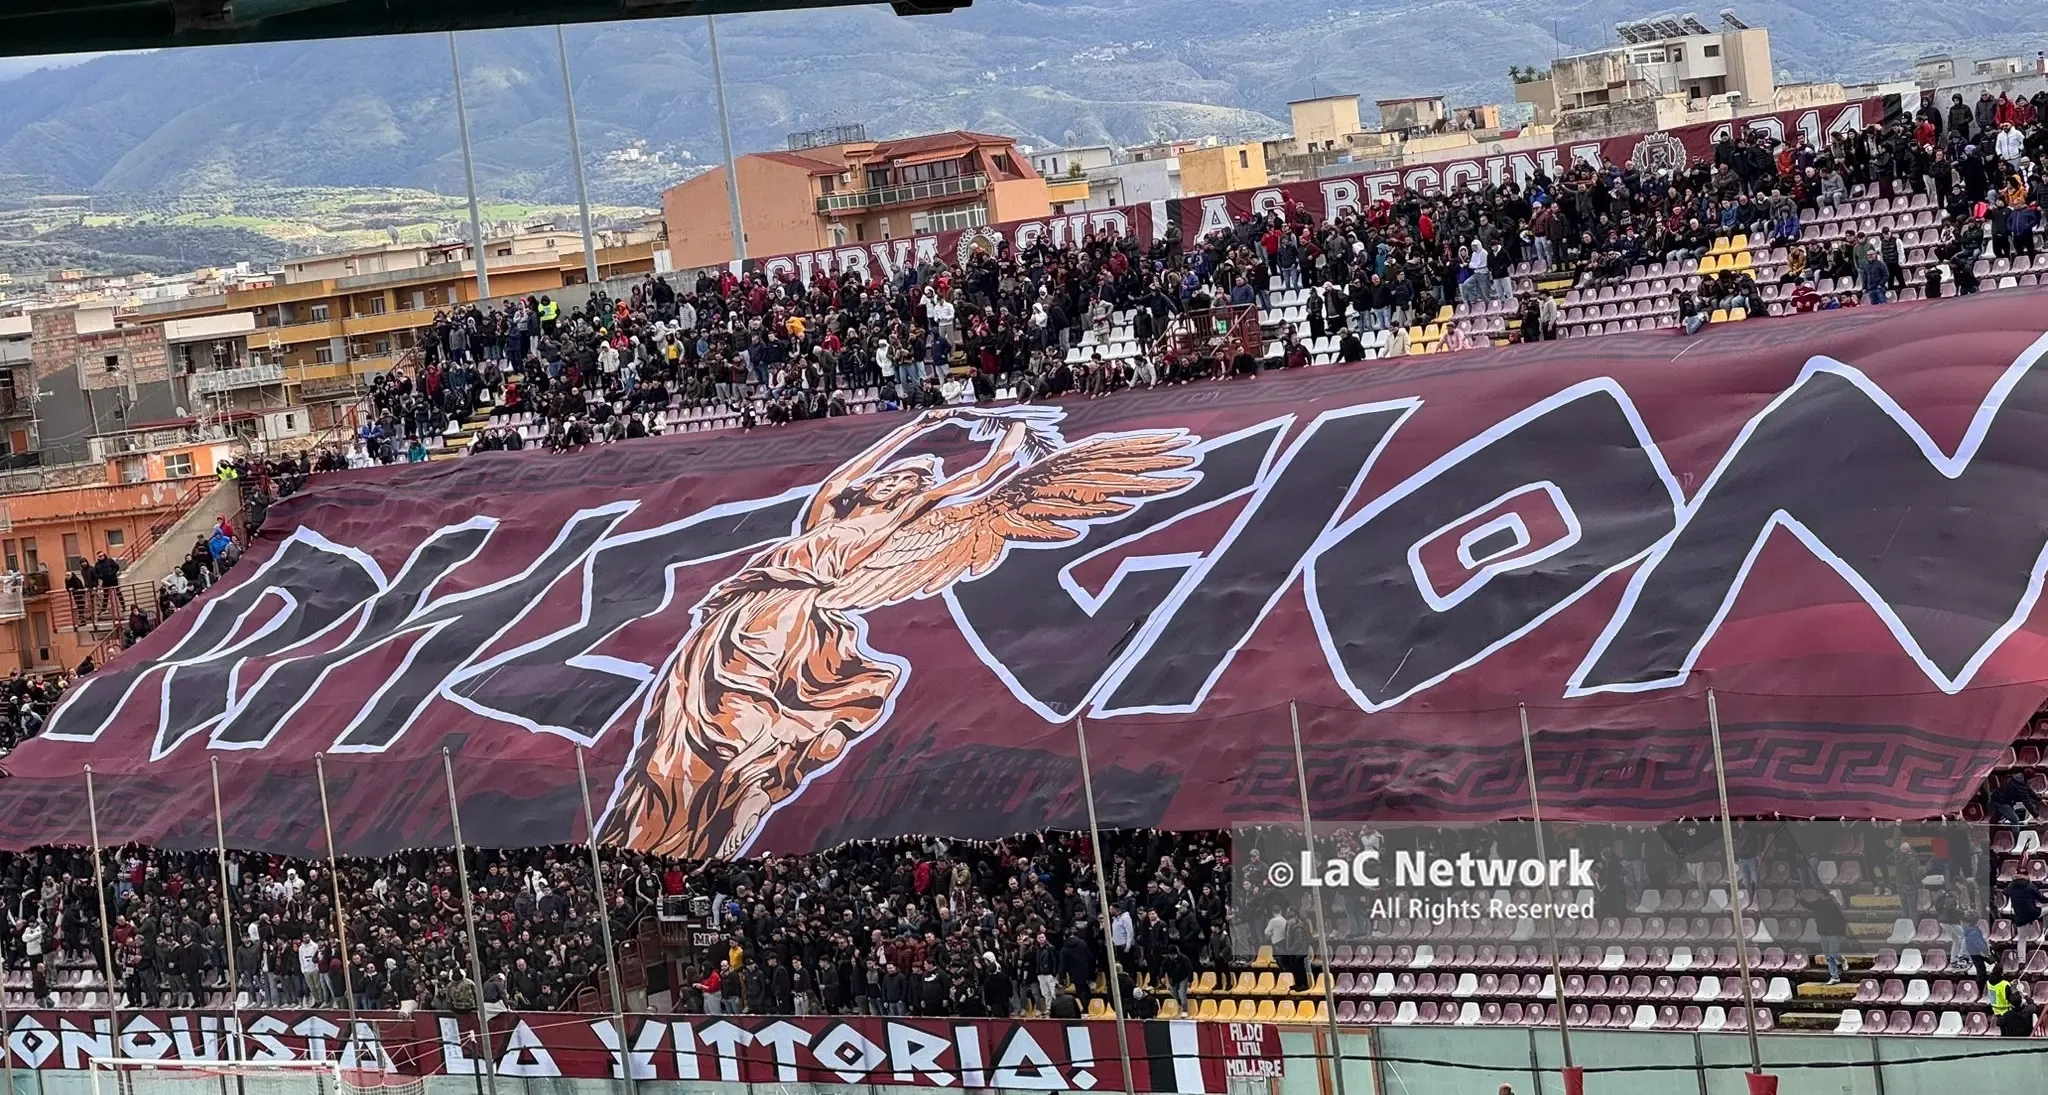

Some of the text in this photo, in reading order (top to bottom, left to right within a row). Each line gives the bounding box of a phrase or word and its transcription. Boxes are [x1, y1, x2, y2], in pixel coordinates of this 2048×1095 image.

[764, 236, 938, 292] CURVA
[1015, 210, 1128, 266] SUD
[0, 1014, 399, 1073] ONQUISTA
[439, 1017, 562, 1076] LA
[1226, 1058, 1284, 1078] MOLLARE
